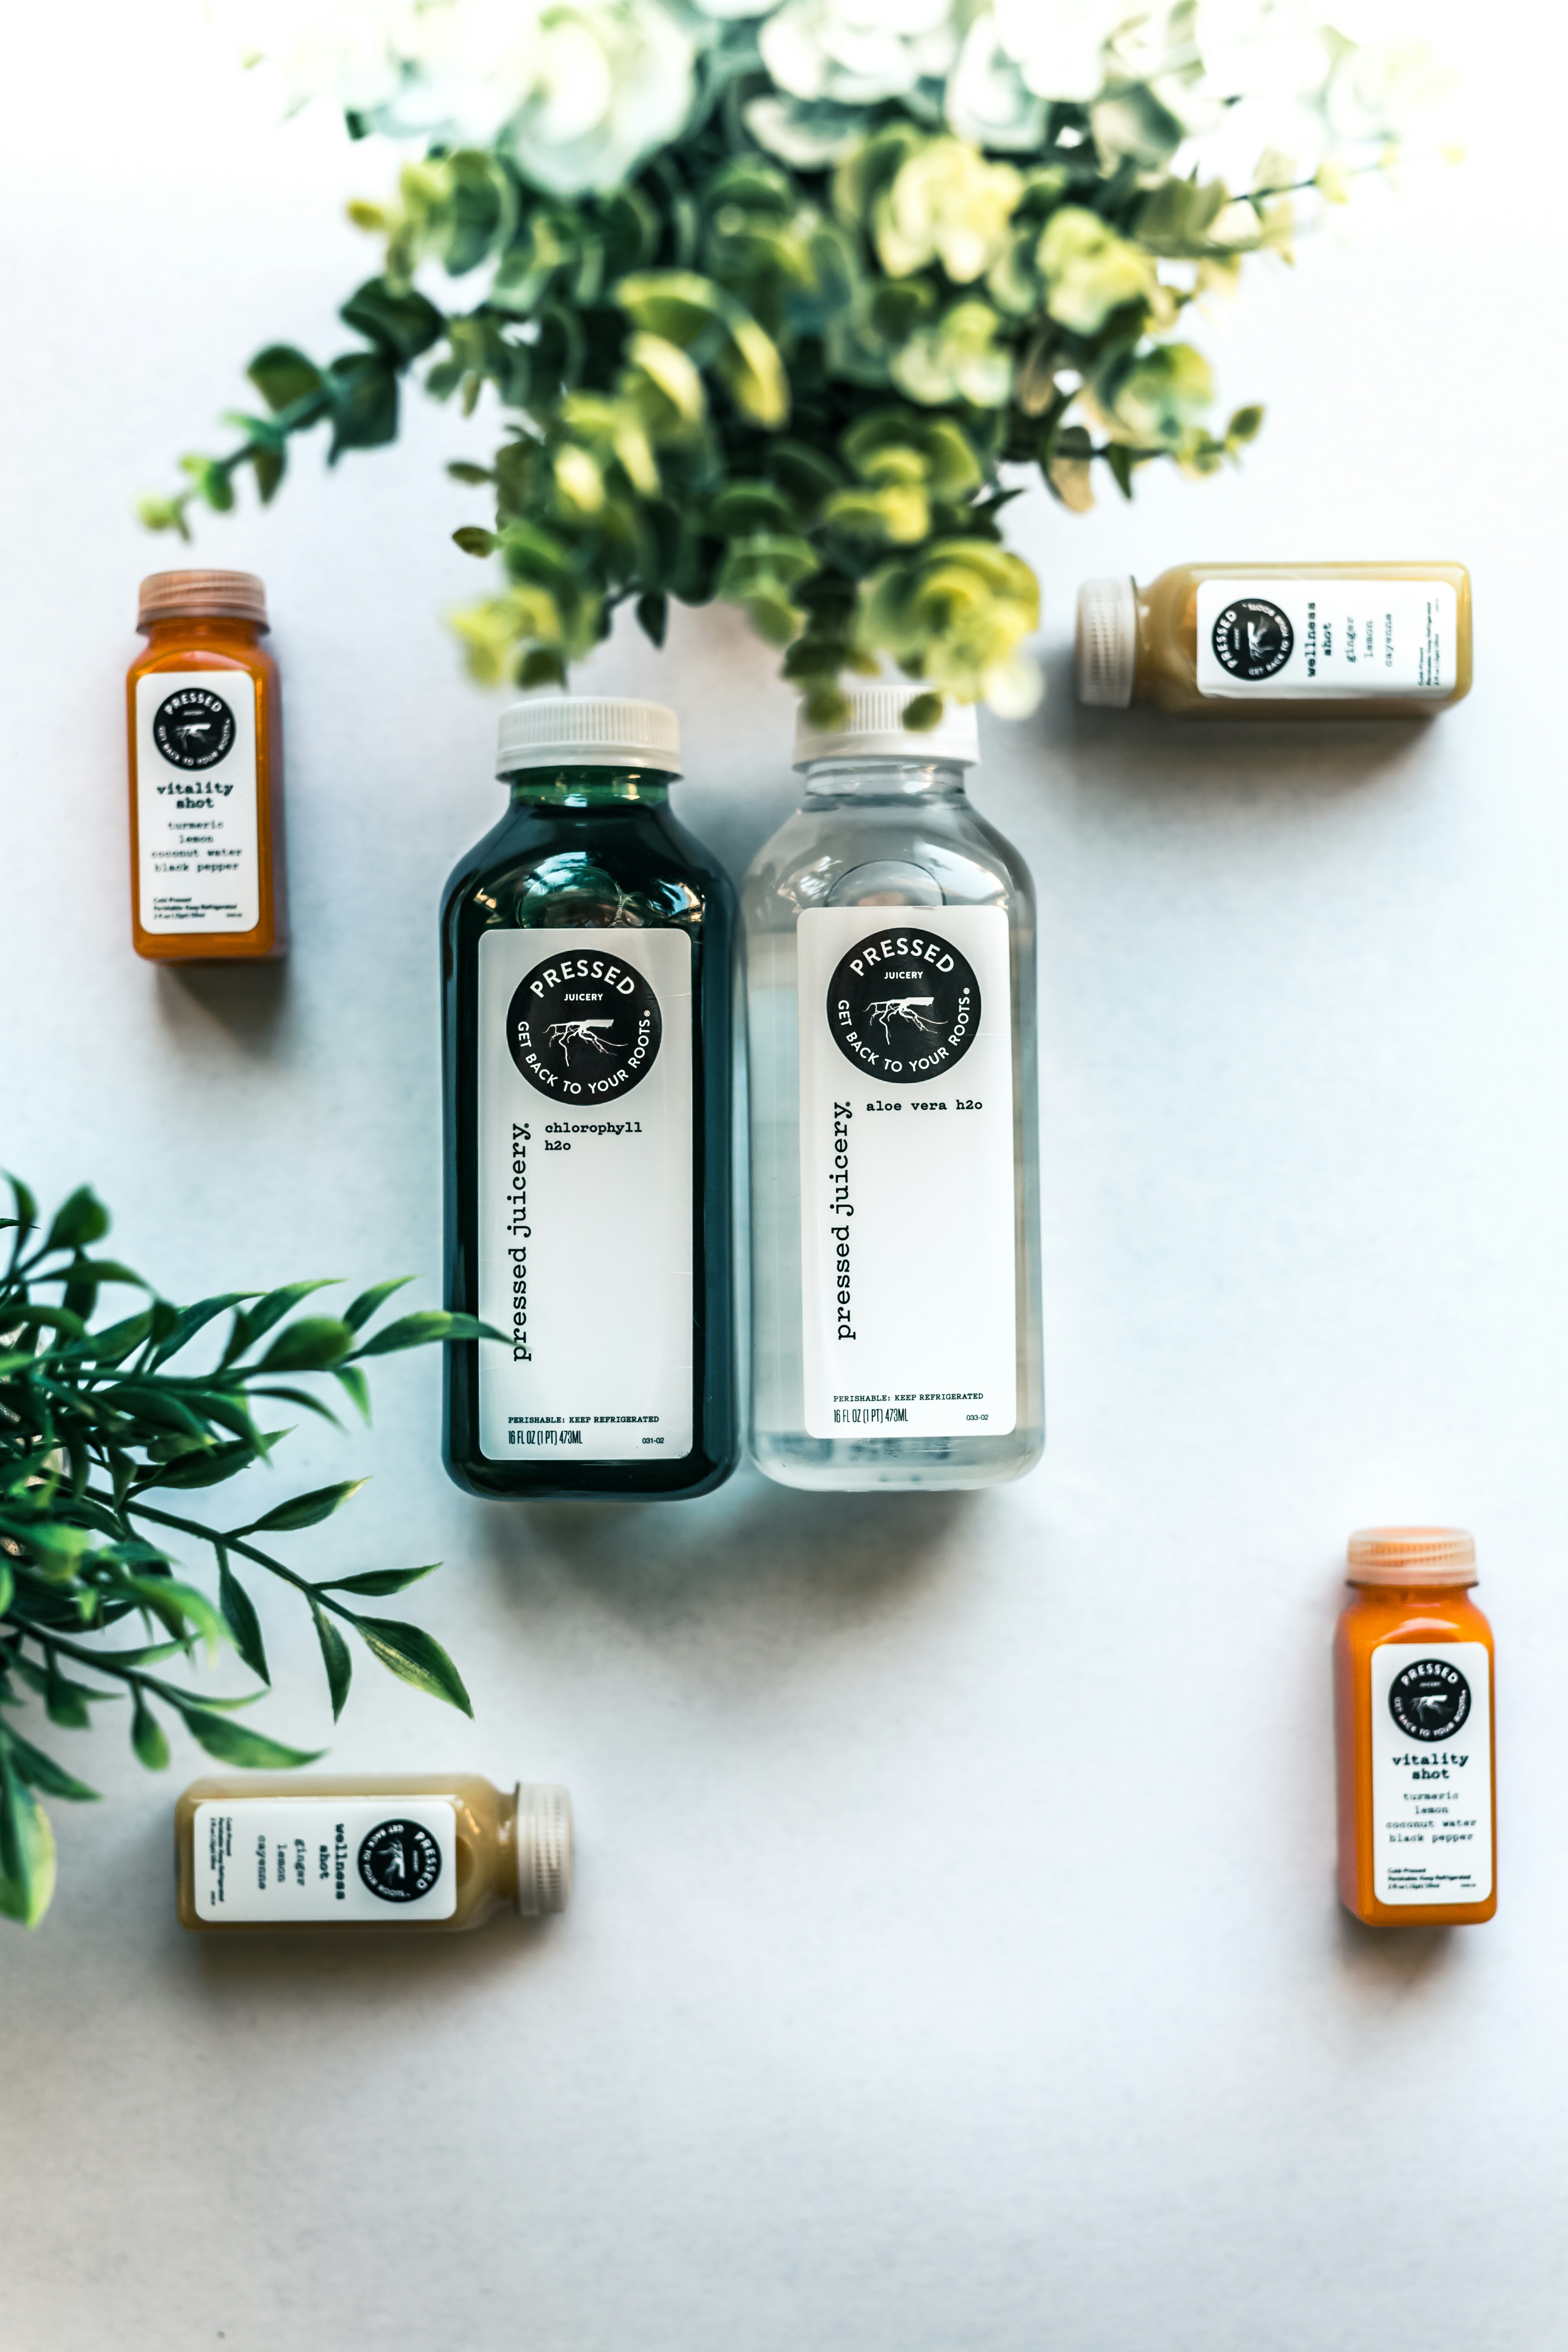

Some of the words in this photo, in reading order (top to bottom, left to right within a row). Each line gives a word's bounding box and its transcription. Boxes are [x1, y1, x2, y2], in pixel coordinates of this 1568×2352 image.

[1216, 609, 1239, 669] PRESSED
[1305, 603, 1316, 677] wellness
[1322, 624, 1331, 656] shot
[1345, 617, 1356, 663] ginger
[1363, 620, 1374, 658] lemon
[1385, 613, 1394, 667] cayenne
[164, 691, 222, 715] PRESSED
[157, 782, 233, 796] vitality
[176, 797, 214, 808] shot
[168, 820, 223, 830] turmeric
[179, 835, 214, 844] lemon
[151, 849, 200, 858] coconut
[206, 849, 242, 857] water
[155, 862, 189, 872] black
[196, 863, 239, 873] pepper
[850, 938, 954, 976] PRESSED
[530, 960, 635, 998] PRESSED
[838, 1000, 852, 1026] GET
[846, 1032, 879, 1065] BACK
[884, 1059, 902, 1072] TO
[909, 1047, 949, 1072] YOUR
[518, 1021, 531, 1047] GET
[526, 1053, 558, 1086] BACK
[564, 1081, 581, 1094] TO
[588, 1069, 629, 1094] YOUR
[867, 1101, 902, 1111] aloe
[956, 1100, 982, 1109] h2o
[545, 1122, 642, 1135] chlorophyll
[545, 1140, 571, 1150] h2o
[829, 1102, 854, 1216] juicery.
[507, 1123, 531, 1238] juicery.
[831, 1225, 855, 1340] pressed
[508, 1247, 532, 1362] pressed
[834, 1410, 840, 1423] 16
[843, 1410, 850, 1422] FL
[853, 1409, 861, 1422] OZ
[864, 1409, 869, 1423] (1
[872, 1409, 883, 1423] PT)
[885, 1409, 908, 1421] 473ML
[508, 1430, 515, 1444] 16
[517, 1431, 525, 1444] FL
[527, 1431, 535, 1444] OZ
[537, 1431, 543, 1445] (1
[546, 1431, 557, 1445] PT)
[559, 1430, 583, 1444] 473ML
[1401, 1664, 1458, 1686] PRESSED
[1393, 1753, 1468, 1767] vitality
[1412, 1768, 1449, 1779] shot
[1403, 1791, 1459, 1801] turmeric
[1415, 1806, 1449, 1815] lemon
[1385, 1820, 1434, 1829] coconut
[1390, 1833, 1424, 1842] black
[1432, 1834, 1473, 1844] pepper
[255, 1835, 266, 1891] cayenne
[276, 1844, 287, 1883] lemon
[294, 1839, 307, 1886] ginger
[320, 1845, 330, 1879] shot
[335, 1824, 347, 1900] wellness
[414, 1832, 437, 1890] PRESSED
